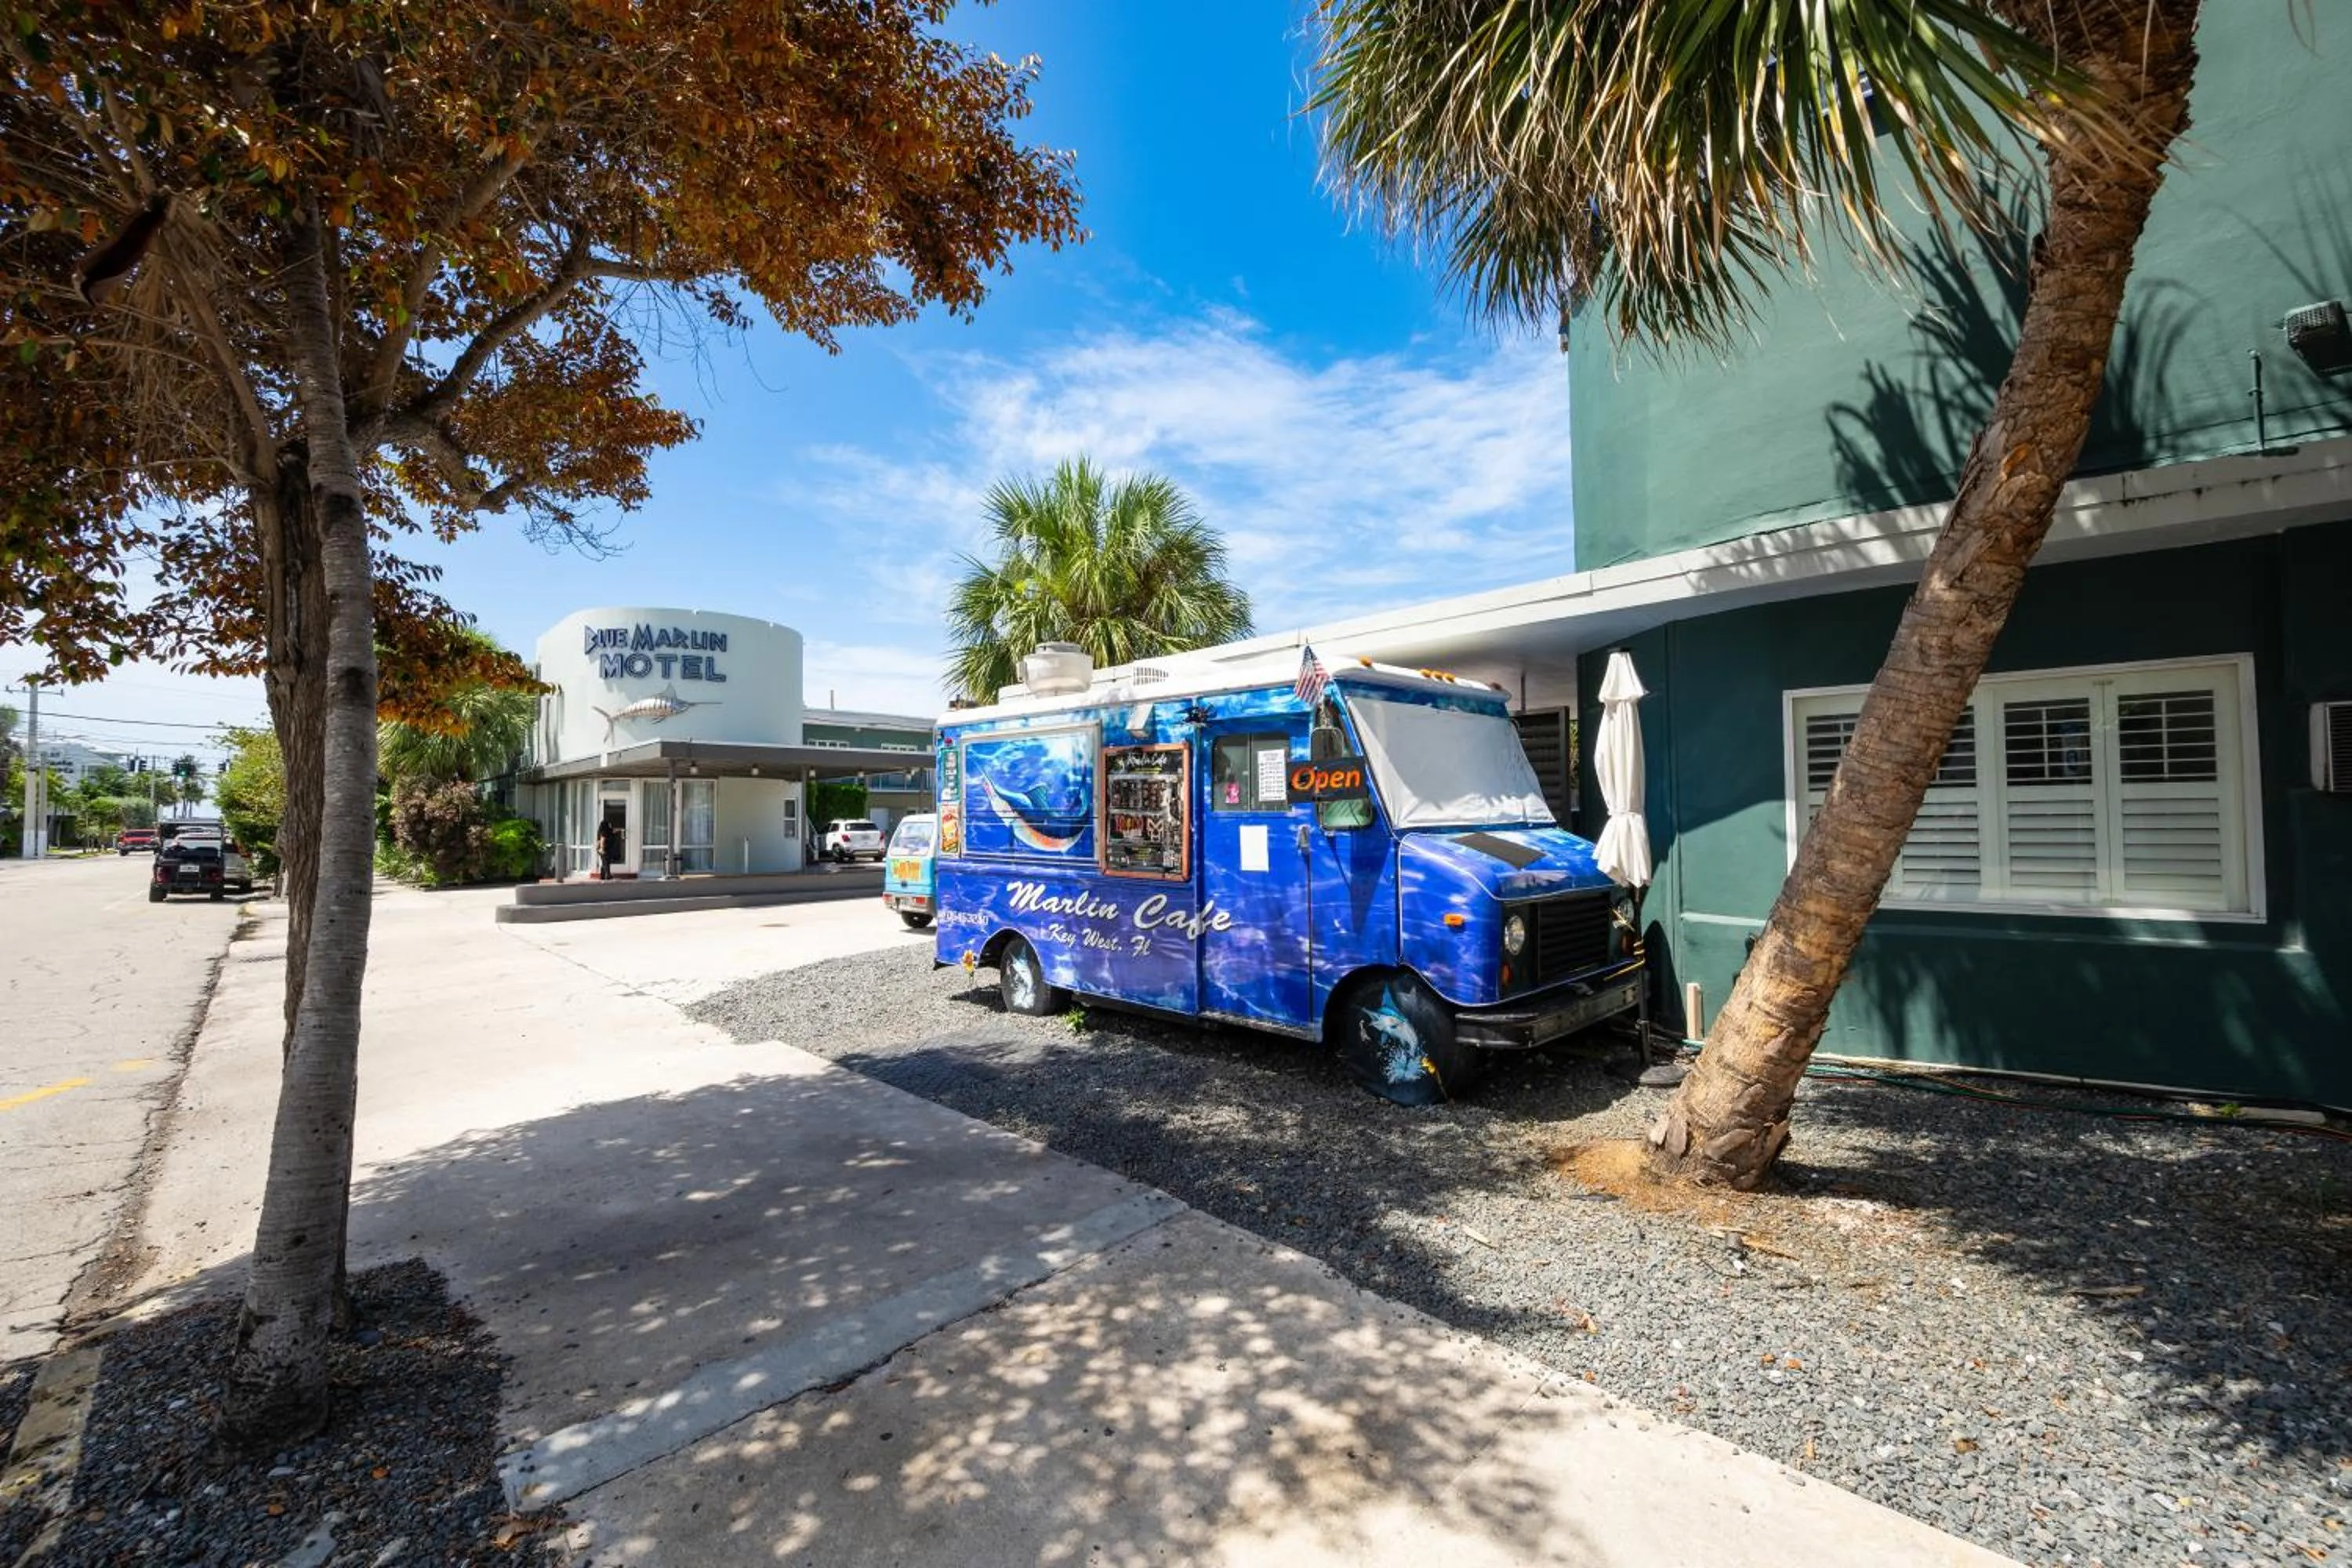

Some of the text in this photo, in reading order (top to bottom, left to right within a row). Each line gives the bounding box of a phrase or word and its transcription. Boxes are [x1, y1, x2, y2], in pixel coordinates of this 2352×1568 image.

[584, 622, 728, 655] BLUE MARLIN
[600, 652, 727, 682] MOTEL
[1290, 764, 1361, 794] Open
[1007, 881, 1233, 940] Marlin Cafe
[1047, 923, 1076, 948] Key
